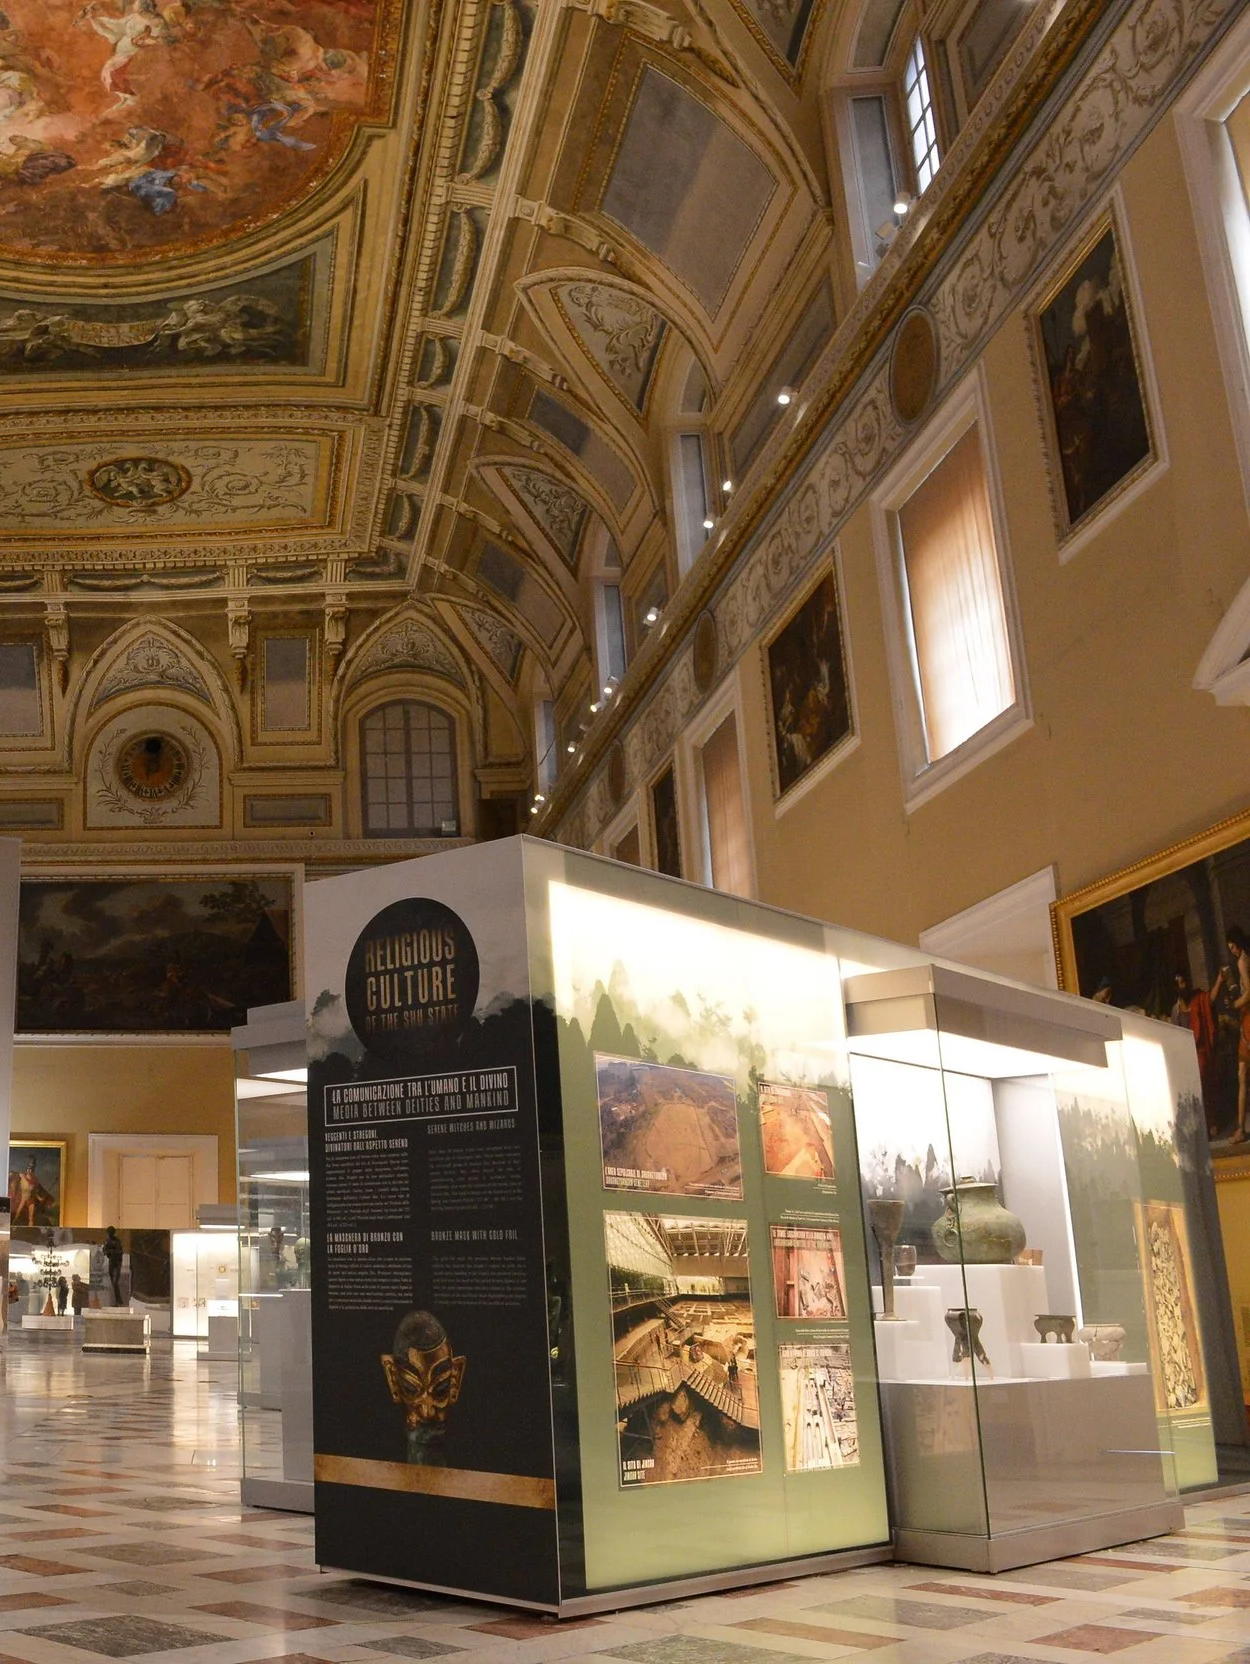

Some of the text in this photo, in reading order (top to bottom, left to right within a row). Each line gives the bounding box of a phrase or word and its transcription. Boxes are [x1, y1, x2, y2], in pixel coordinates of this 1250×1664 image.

[365, 927, 455, 973] RELIGIOUS
[366, 963, 456, 1012] CULTURE
[381, 1012, 399, 1031] THE
[403, 1008, 423, 1029] SHU
[332, 1072, 508, 1103] LA COMUNICAZIONE TRA L'UMANO E IL DIVINO
[332, 1090, 509, 1120] MEDIA BETWEEN DEITIES AND MANKIND
[427, 1123, 448, 1134] SERENE
[475, 1120, 488, 1131] AND
[327, 1232, 333, 1243] LA
[363, 1231, 369, 1242] DI
[392, 1231, 403, 1242] CON
[431, 1229, 518, 1241] BRONZE MASK WITH GOLD FOIL
[327, 1244, 333, 1254] LA
